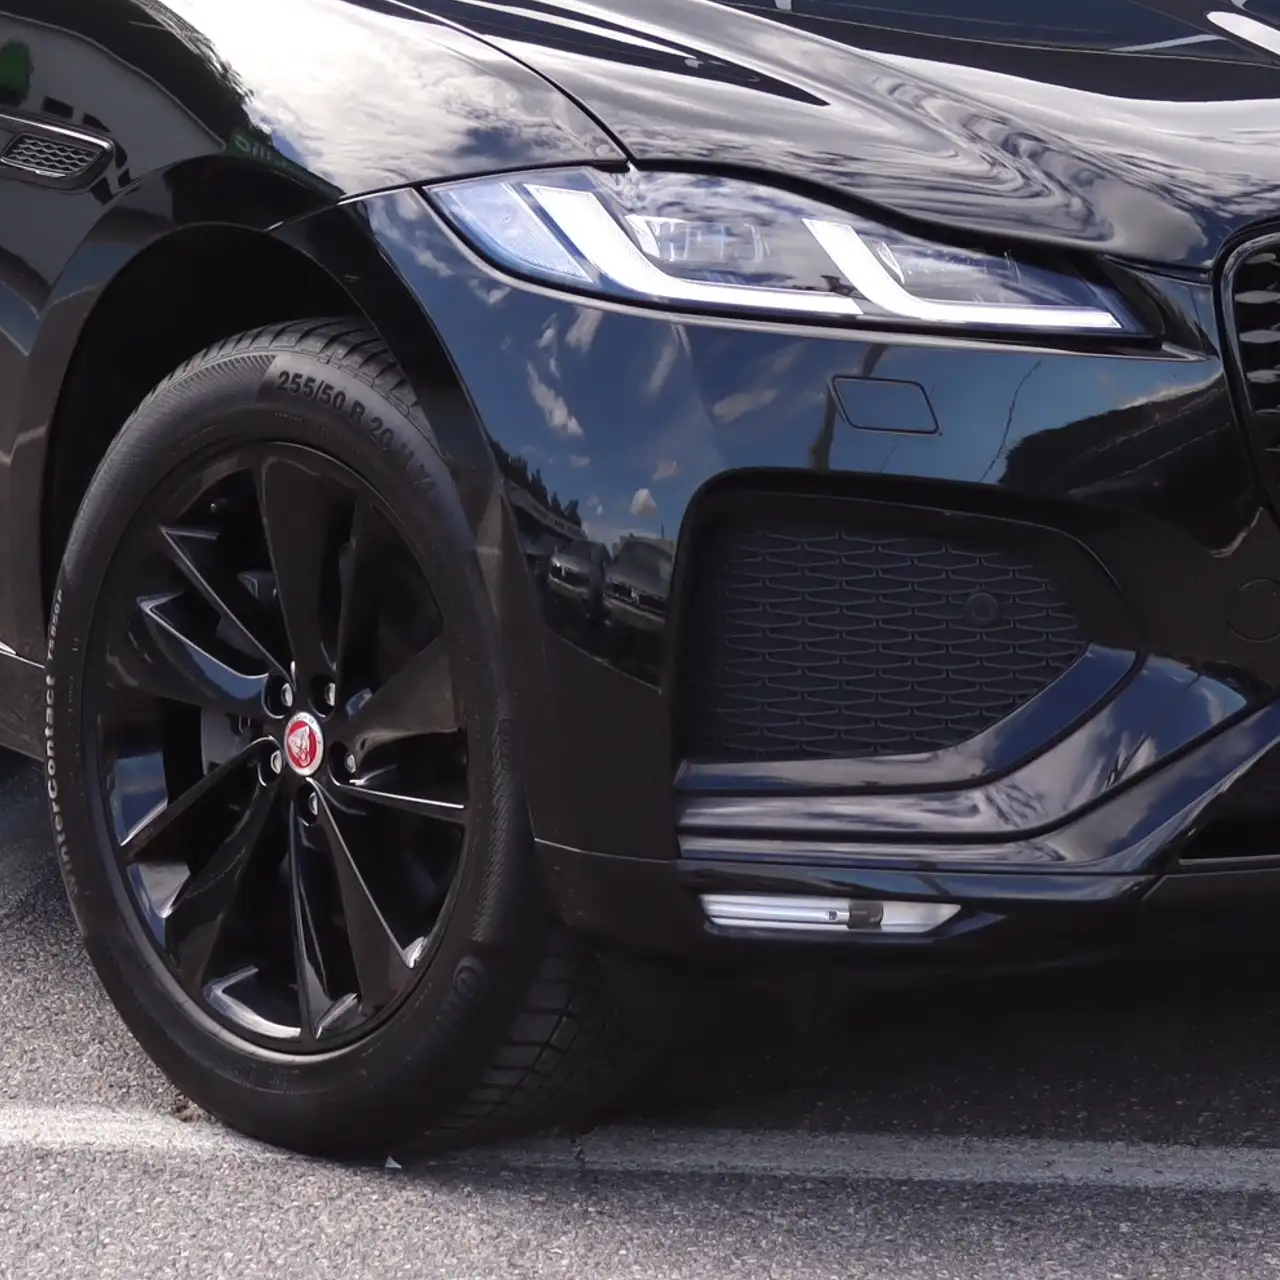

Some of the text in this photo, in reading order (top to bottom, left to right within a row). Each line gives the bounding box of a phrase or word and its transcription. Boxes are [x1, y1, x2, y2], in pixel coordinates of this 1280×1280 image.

[276, 369, 396, 451] 255/50 R 20
